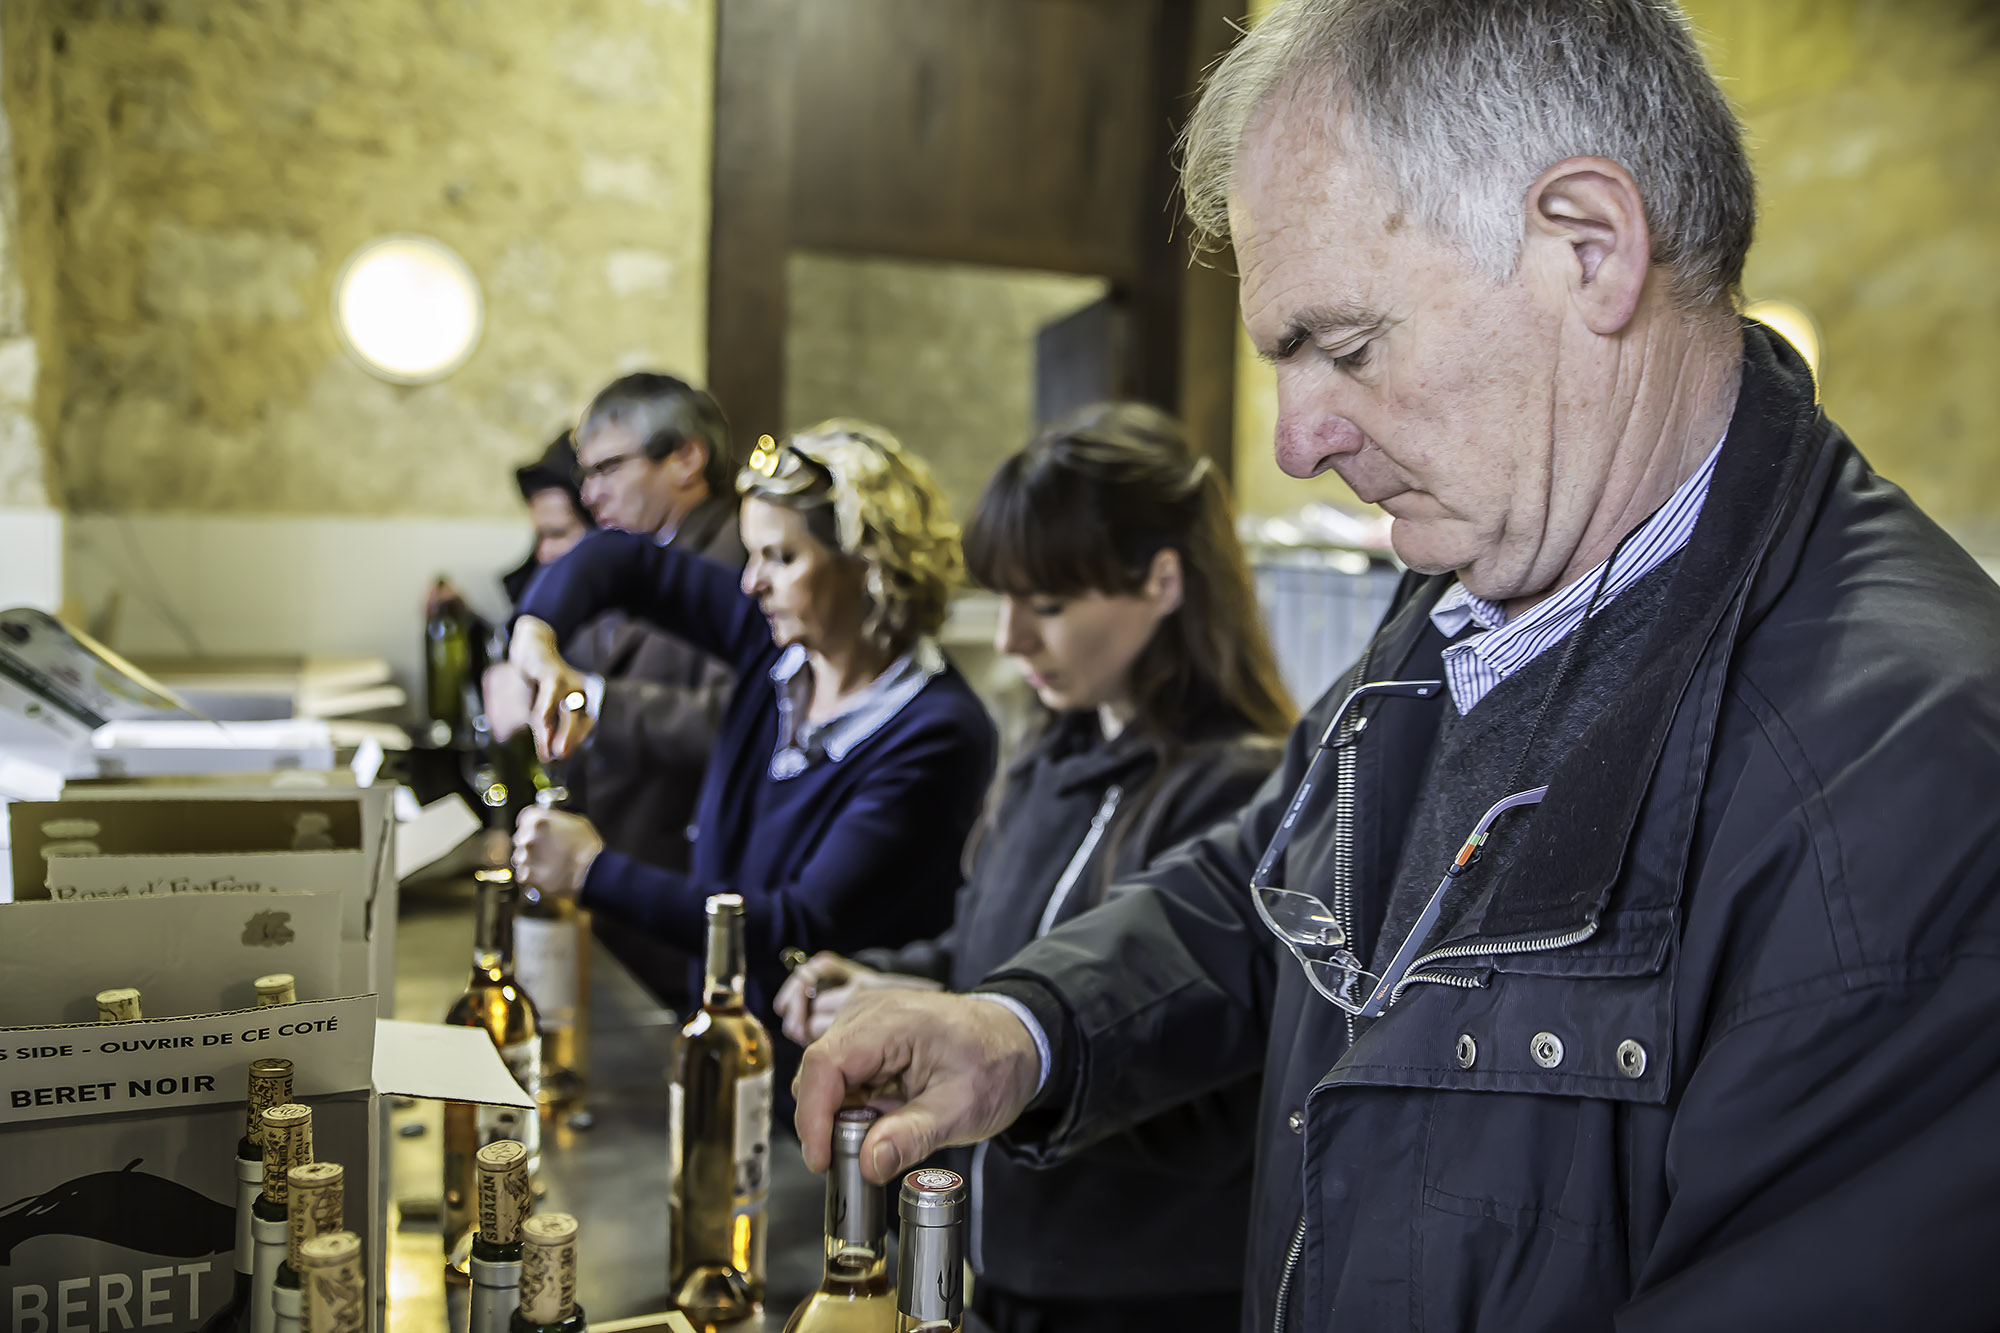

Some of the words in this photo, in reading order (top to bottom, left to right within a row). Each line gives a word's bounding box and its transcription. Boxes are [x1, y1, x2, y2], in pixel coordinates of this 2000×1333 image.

[16, 1045, 73, 1060] SIDE
[100, 1036, 194, 1054] OUVRIR
[202, 1033, 233, 1046] DE
[241, 1028, 270, 1043] CE
[278, 1016, 338, 1037] COTÉ
[10, 1082, 116, 1108] BERET
[128, 1075, 216, 1099] NOIR
[483, 1175, 498, 1241] SABAZAN
[12, 1262, 212, 1333] BERET
